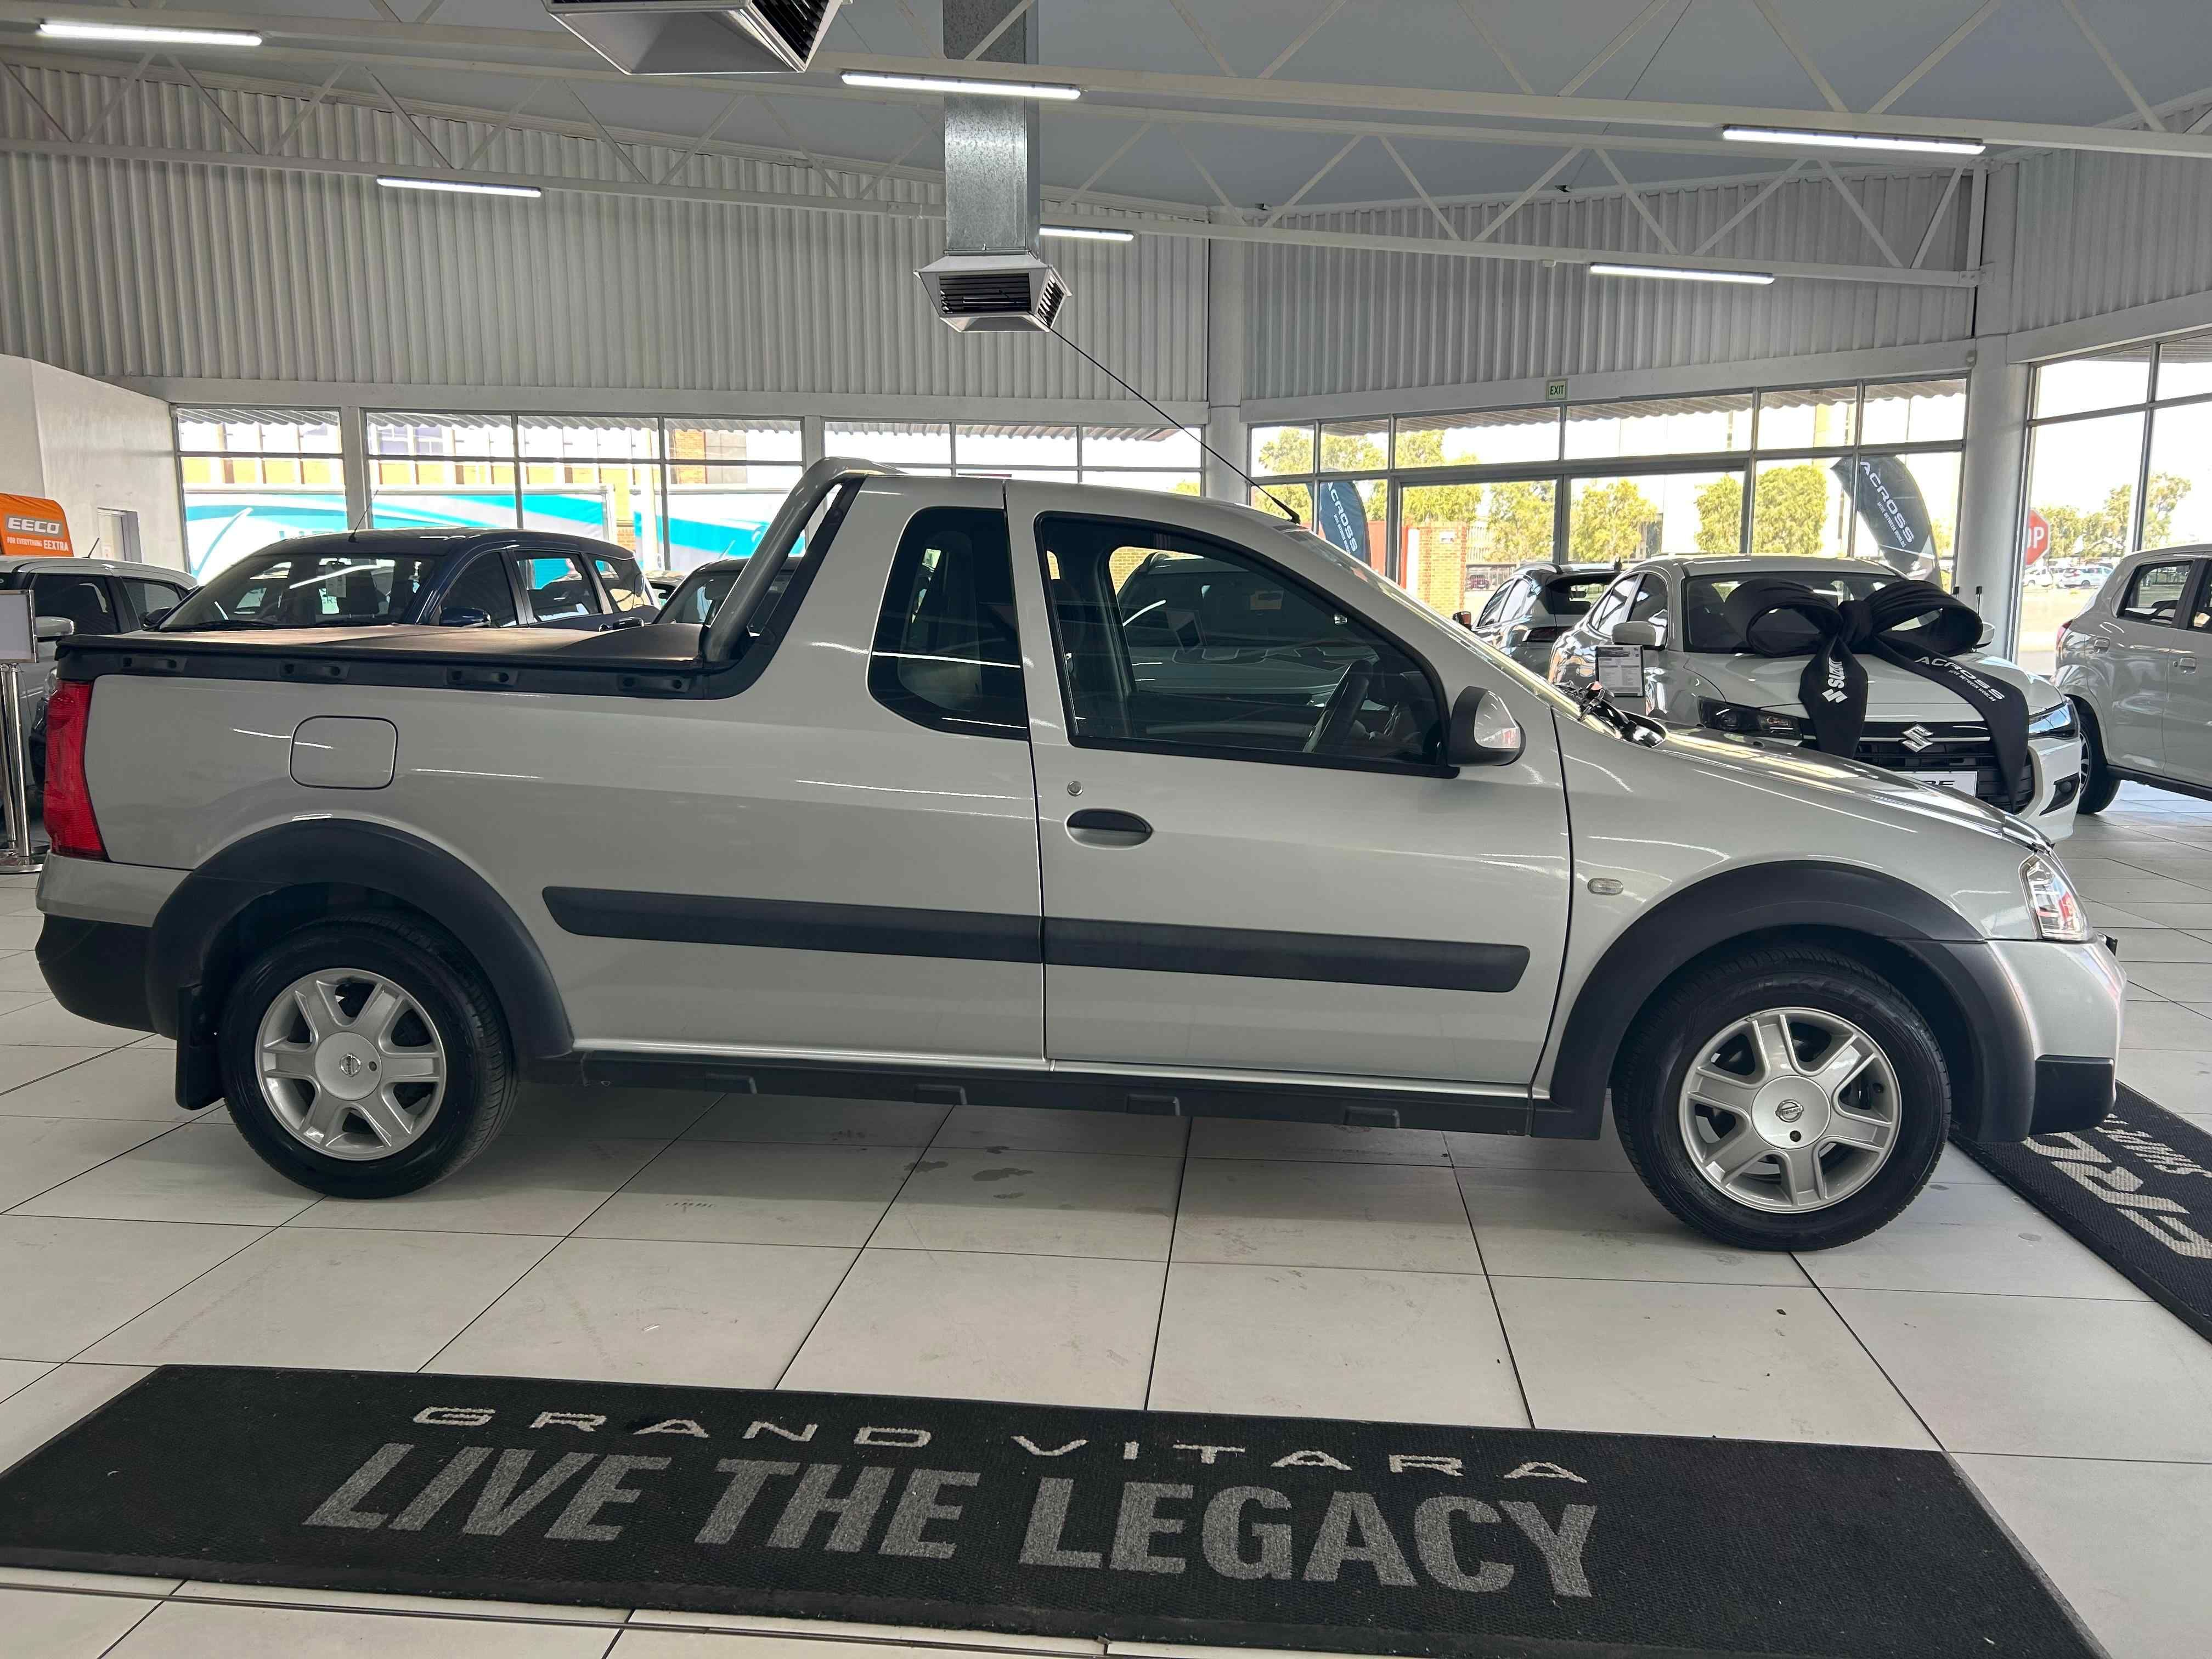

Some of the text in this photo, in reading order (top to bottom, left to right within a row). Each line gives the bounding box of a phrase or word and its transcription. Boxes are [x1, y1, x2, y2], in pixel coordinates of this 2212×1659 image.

[1550, 385, 1564, 395] EXIT
[8, 517, 60, 534] EECO
[1860, 461, 1914, 543] ACROSS
[16, 538, 43, 547] EVERYTHING
[43, 539, 69, 551] EEXTRA
[1914, 656, 2005, 699] ACROSS
[2021, 1132, 2212, 1259] FRO
[413, 1407, 1587, 1483] GRAND VITARA
[302, 1442, 1597, 1598] LIVE THE LEGACY
